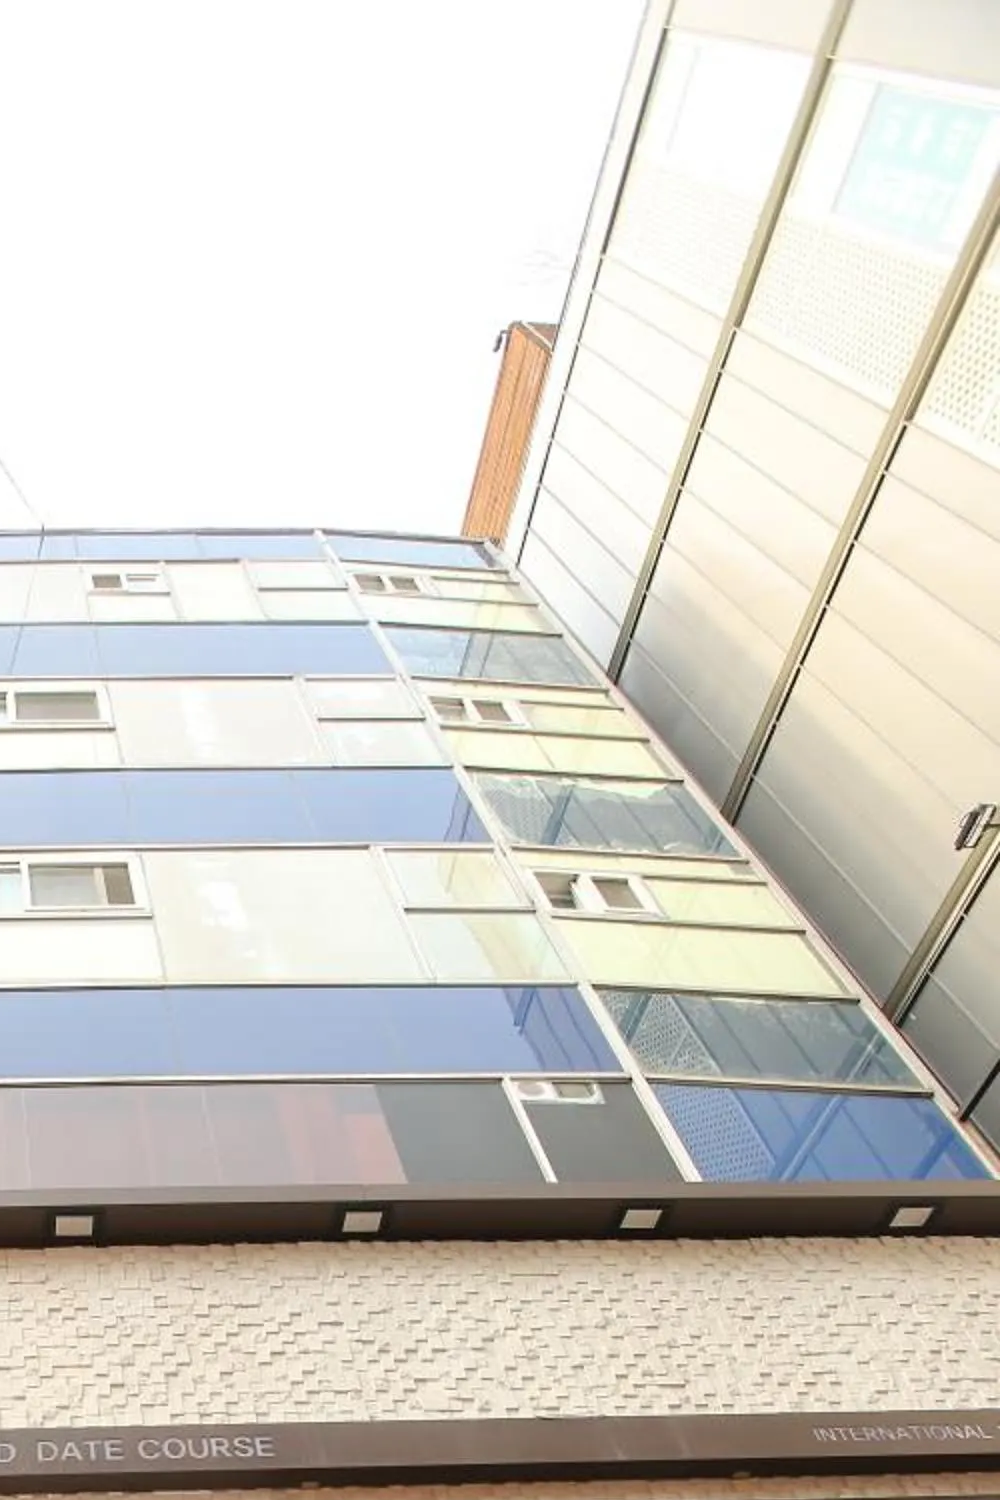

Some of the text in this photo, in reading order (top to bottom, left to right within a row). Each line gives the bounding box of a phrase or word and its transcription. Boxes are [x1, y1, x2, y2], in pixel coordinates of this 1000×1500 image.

[812, 1424, 993, 1442] INTERNATIONAL
[36, 1438, 124, 1462] DATE
[137, 1436, 275, 1460] COURSE
